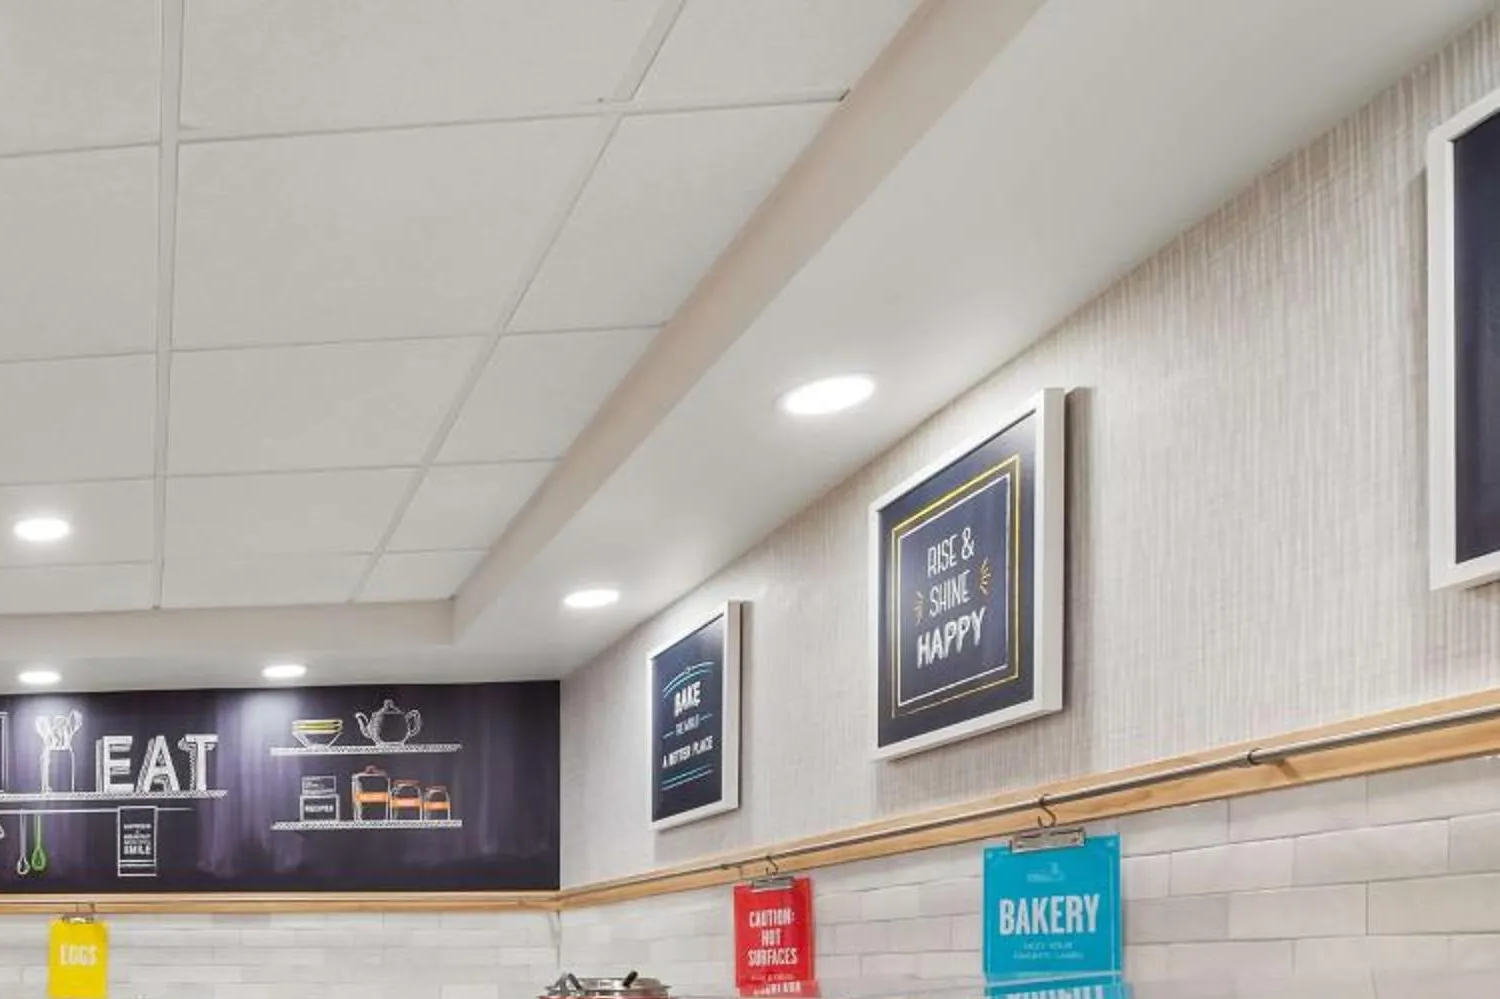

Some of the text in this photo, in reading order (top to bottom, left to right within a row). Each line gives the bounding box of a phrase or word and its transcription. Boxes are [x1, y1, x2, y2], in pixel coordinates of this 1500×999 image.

[927, 527, 975, 578] RISE &
[929, 569, 970, 617] SHINE
[917, 607, 986, 668] HAPPY
[674, 681, 701, 717] BAKE
[96, 734, 218, 793] EAT
[692, 736, 714, 757] PLACE
[999, 893, 1100, 935] BAKERY
[747, 947, 799, 967] SURFACES
[761, 928, 782, 947] HOT
